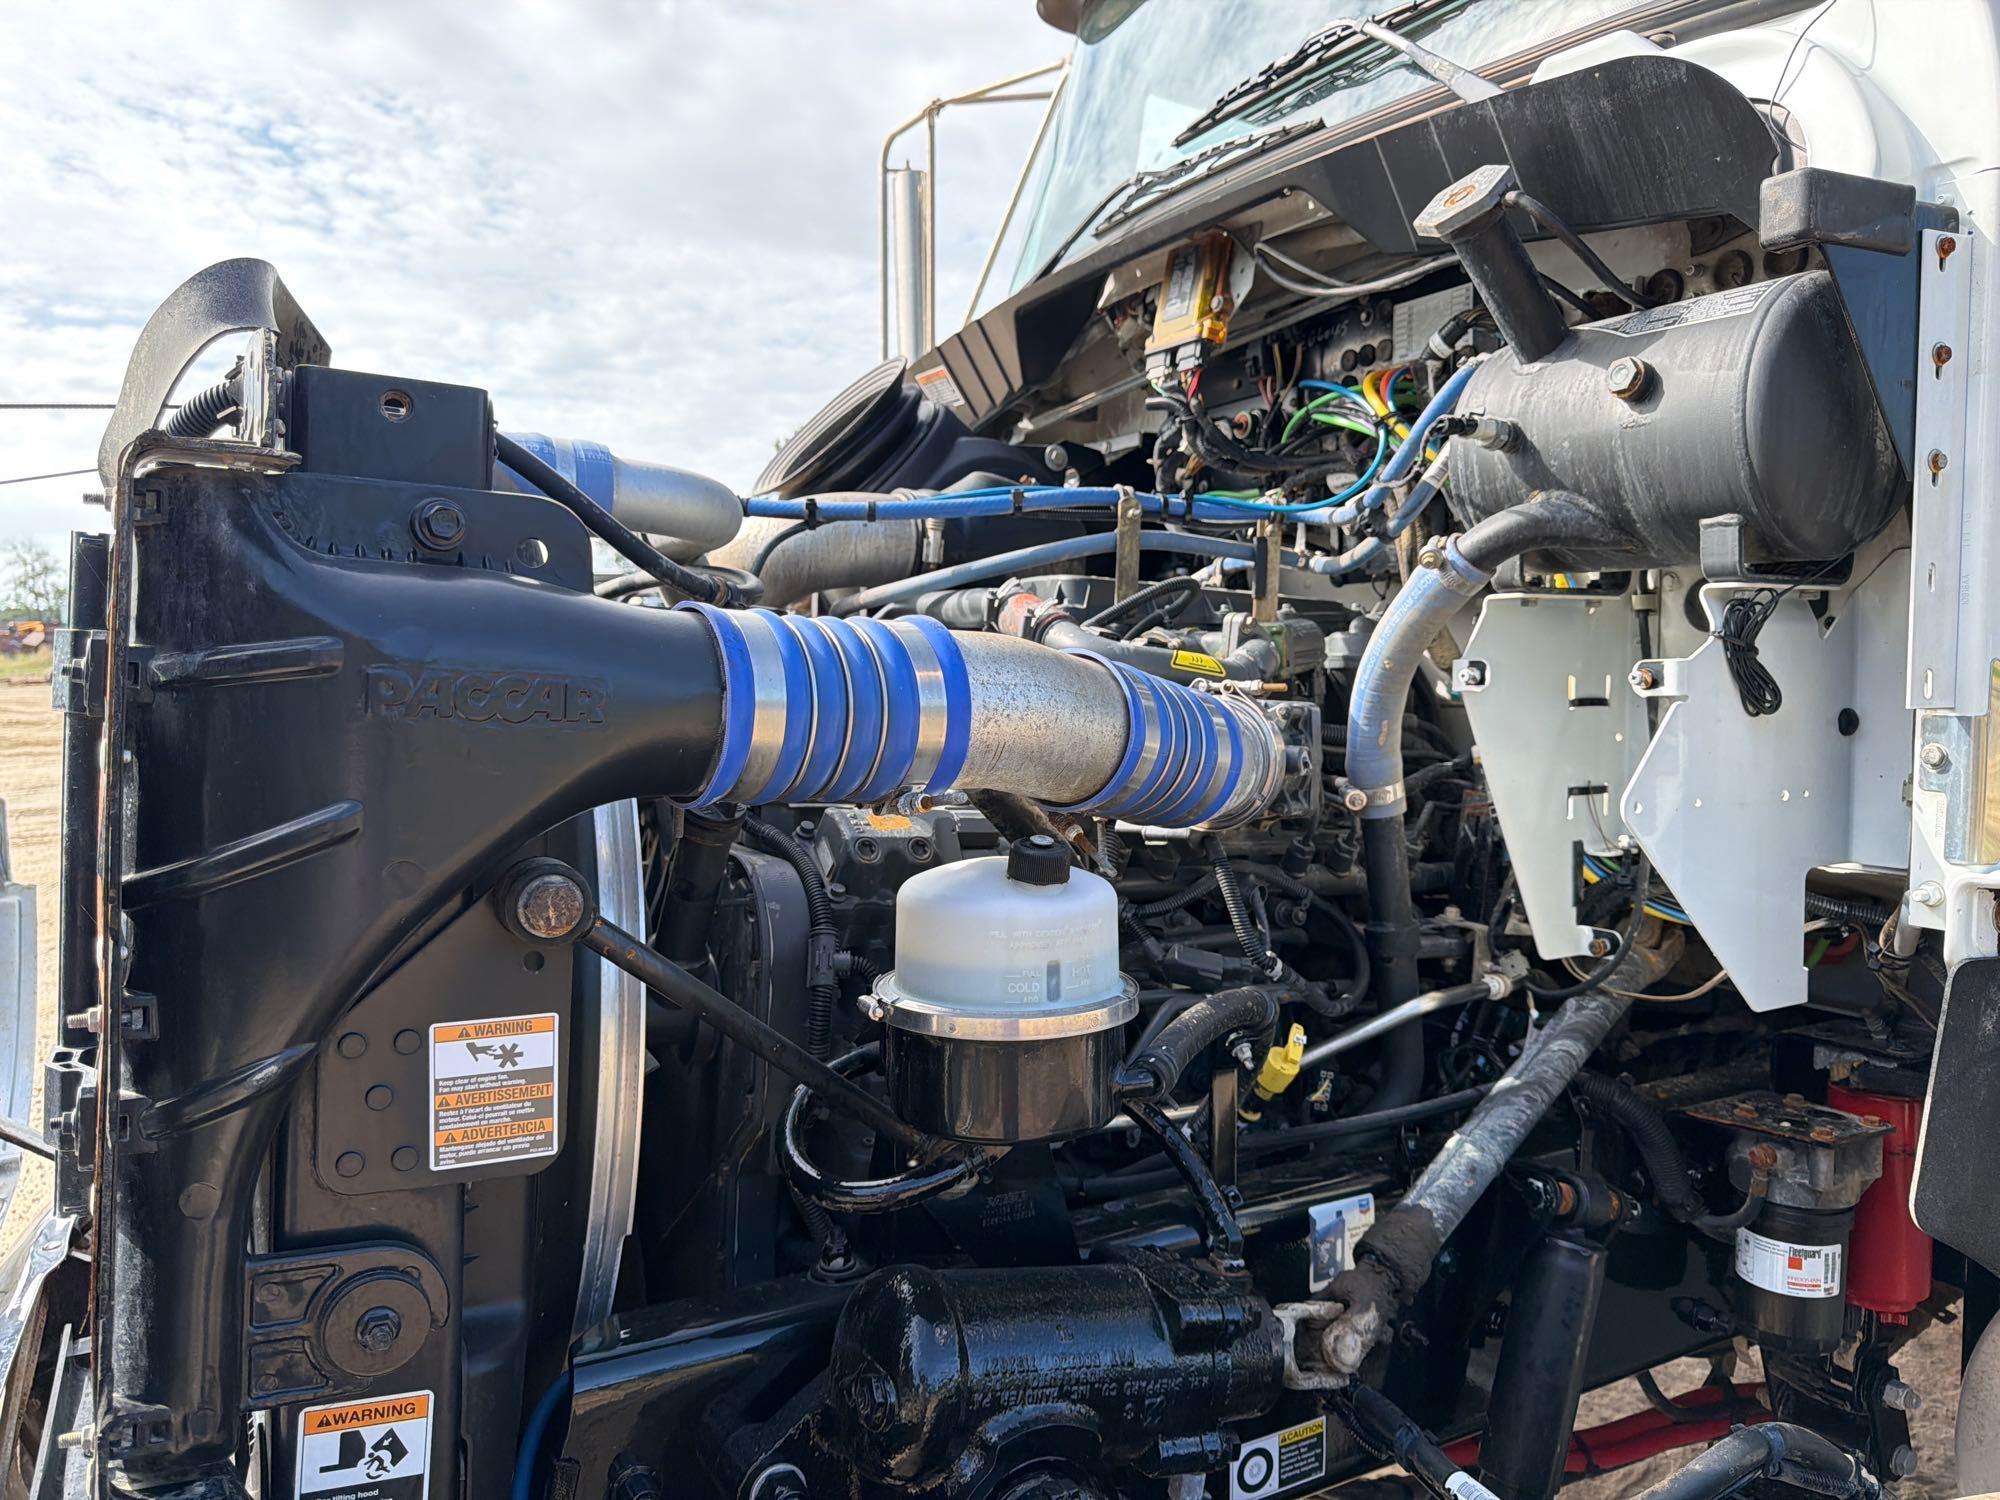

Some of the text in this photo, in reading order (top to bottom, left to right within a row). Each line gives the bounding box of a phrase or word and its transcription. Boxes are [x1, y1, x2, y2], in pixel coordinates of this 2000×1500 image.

[364, 665, 606, 724] PACCAR
[1007, 982, 1040, 993] COLD
[474, 1020, 533, 1038] WARNING
[477, 1075, 497, 1083] engine
[455, 1084, 552, 1106] AVERTISSEMENT
[461, 1120, 546, 1141] ADVERTENCIA
[1124, 1377, 1183, 1396] SHEPPARD
[333, 1402, 416, 1425] WARNING
[1287, 1423, 1324, 1440] CAUTION
[357, 1488, 379, 1498] hood
